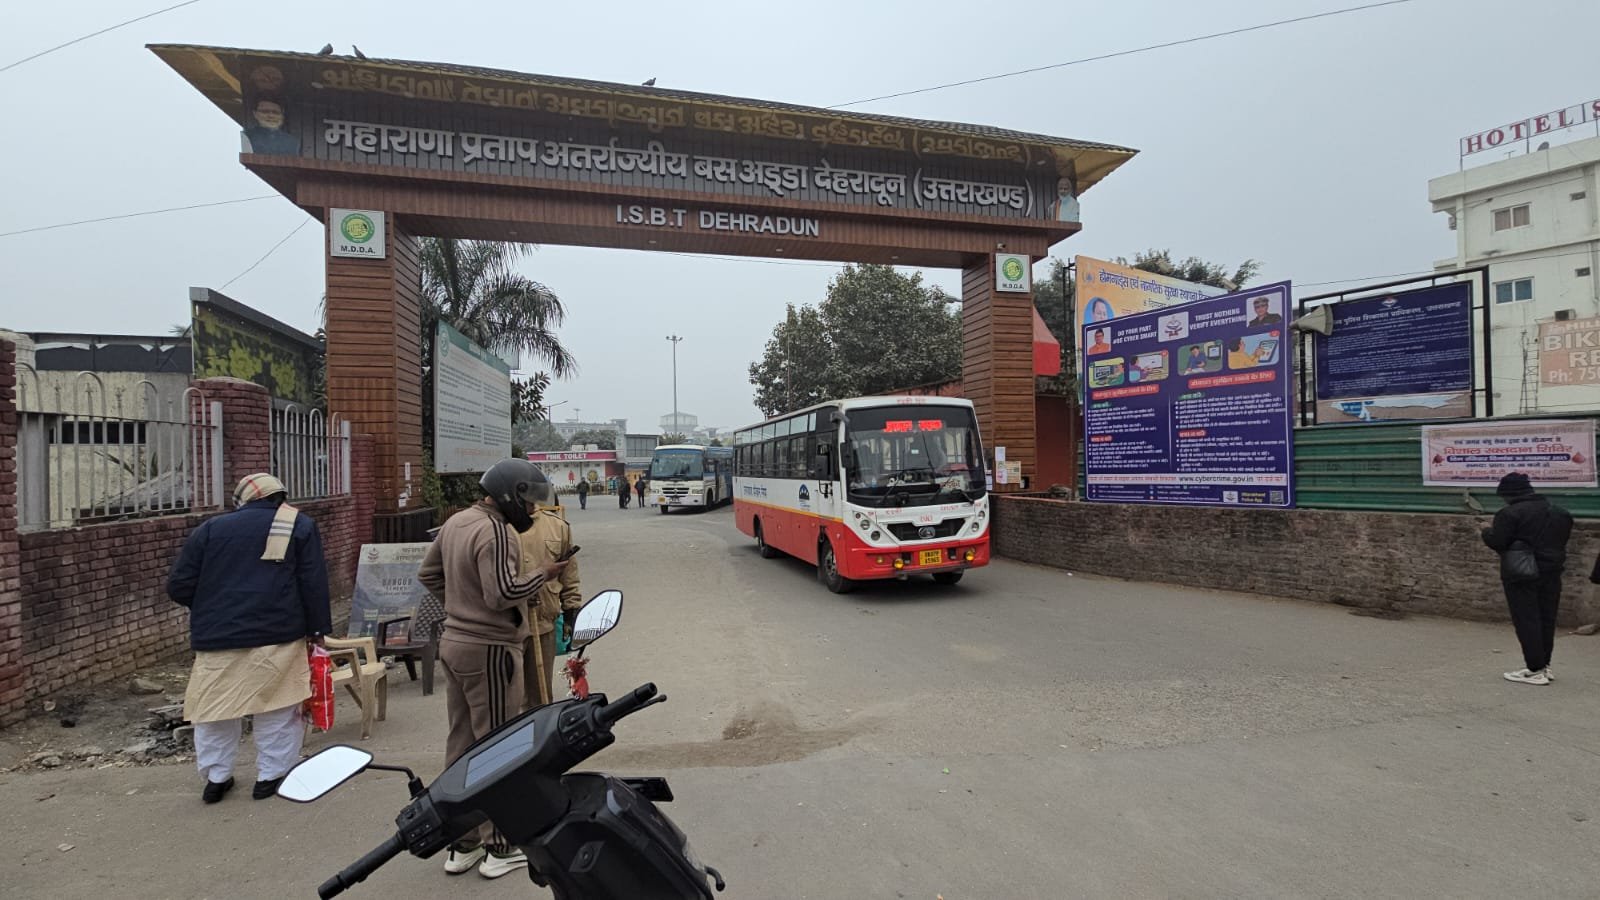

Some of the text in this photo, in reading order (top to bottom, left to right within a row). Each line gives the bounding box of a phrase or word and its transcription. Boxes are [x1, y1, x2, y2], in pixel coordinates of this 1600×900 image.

[1466, 109, 1574, 154] HOTEL
[323, 118, 455, 157] महाराणा
[459, 132, 539, 164] प्रताप
[541, 137, 689, 179] अंतर्राज्यीय
[693, 155, 738, 182] बस
[813, 157, 906, 206] देहरादून
[913, 168, 1034, 217] (उत्तराखण्ड)
[616, 205, 819, 237] I.S.B.T DEHRADUN
[341, 245, 376, 254] M.D.D.A.
[1195, 308, 1240, 321] TRUST NOTHING
[1189, 315, 1247, 330] VERIFY EVERYTHING
[1124, 335, 1139, 343] CYBER
[1140, 331, 1157, 340] SMART
[1543, 330, 1600, 351] BIK
[1549, 368, 1573, 382] Ph:
[1179, 475, 1254, 484] www.cybercrime.gov.in
